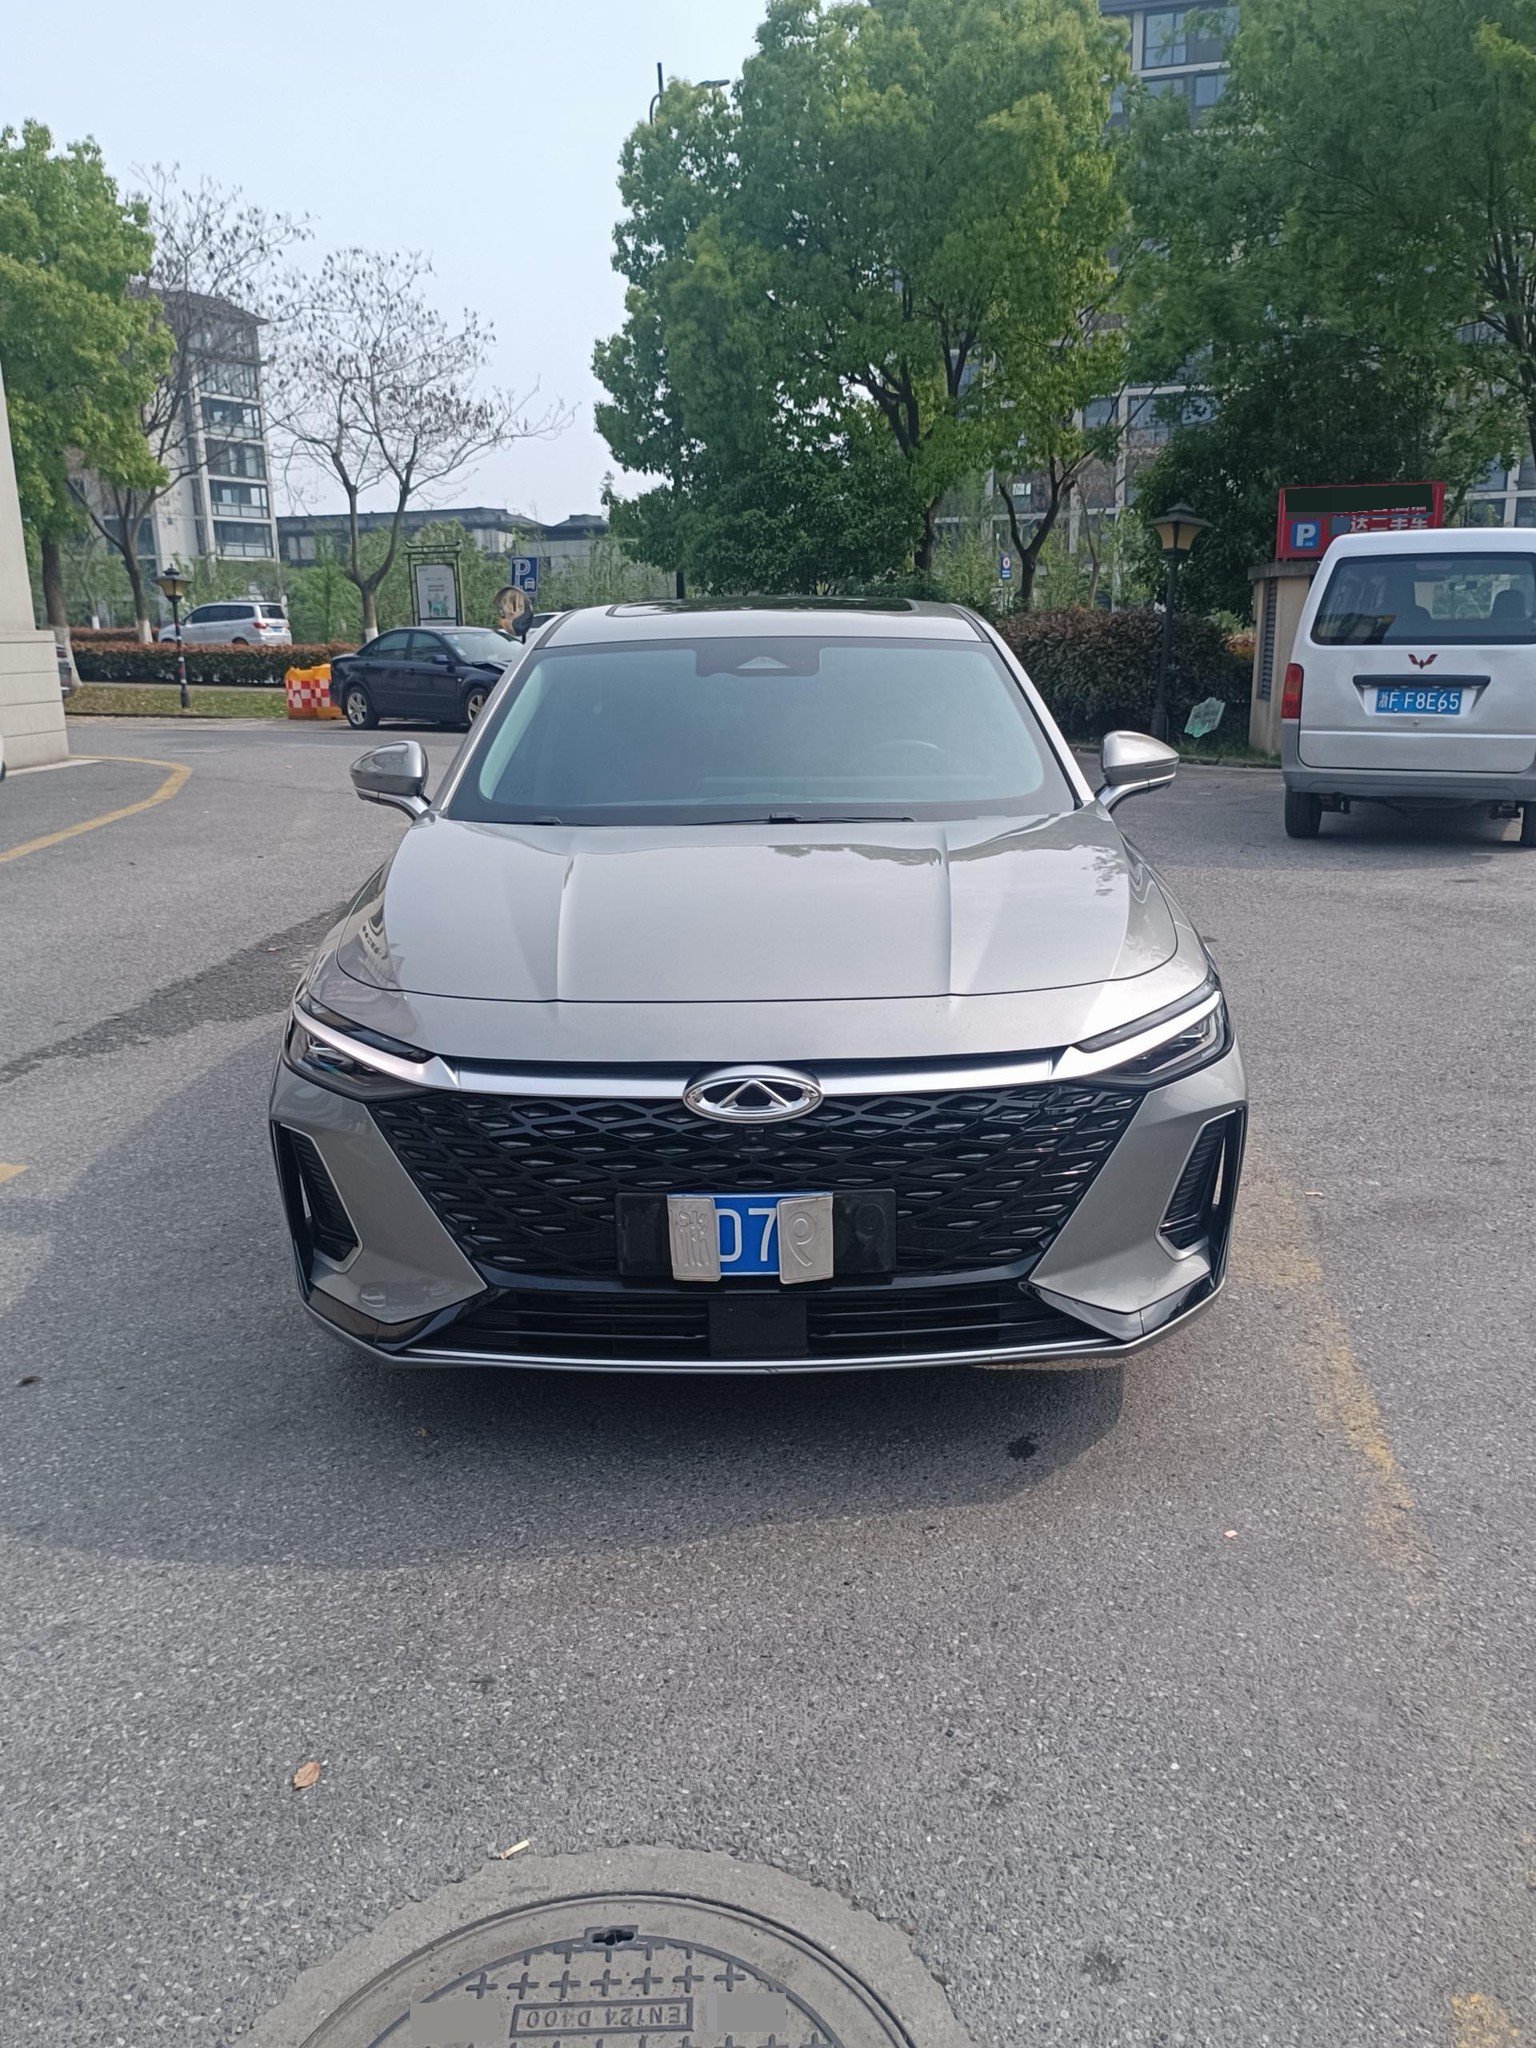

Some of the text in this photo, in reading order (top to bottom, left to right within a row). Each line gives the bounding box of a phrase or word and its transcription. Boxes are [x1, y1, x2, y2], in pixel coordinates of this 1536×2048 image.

[1296, 523, 1316, 547] P
[513, 559, 531, 589] P
[604, 2006, 682, 2027] EN124
